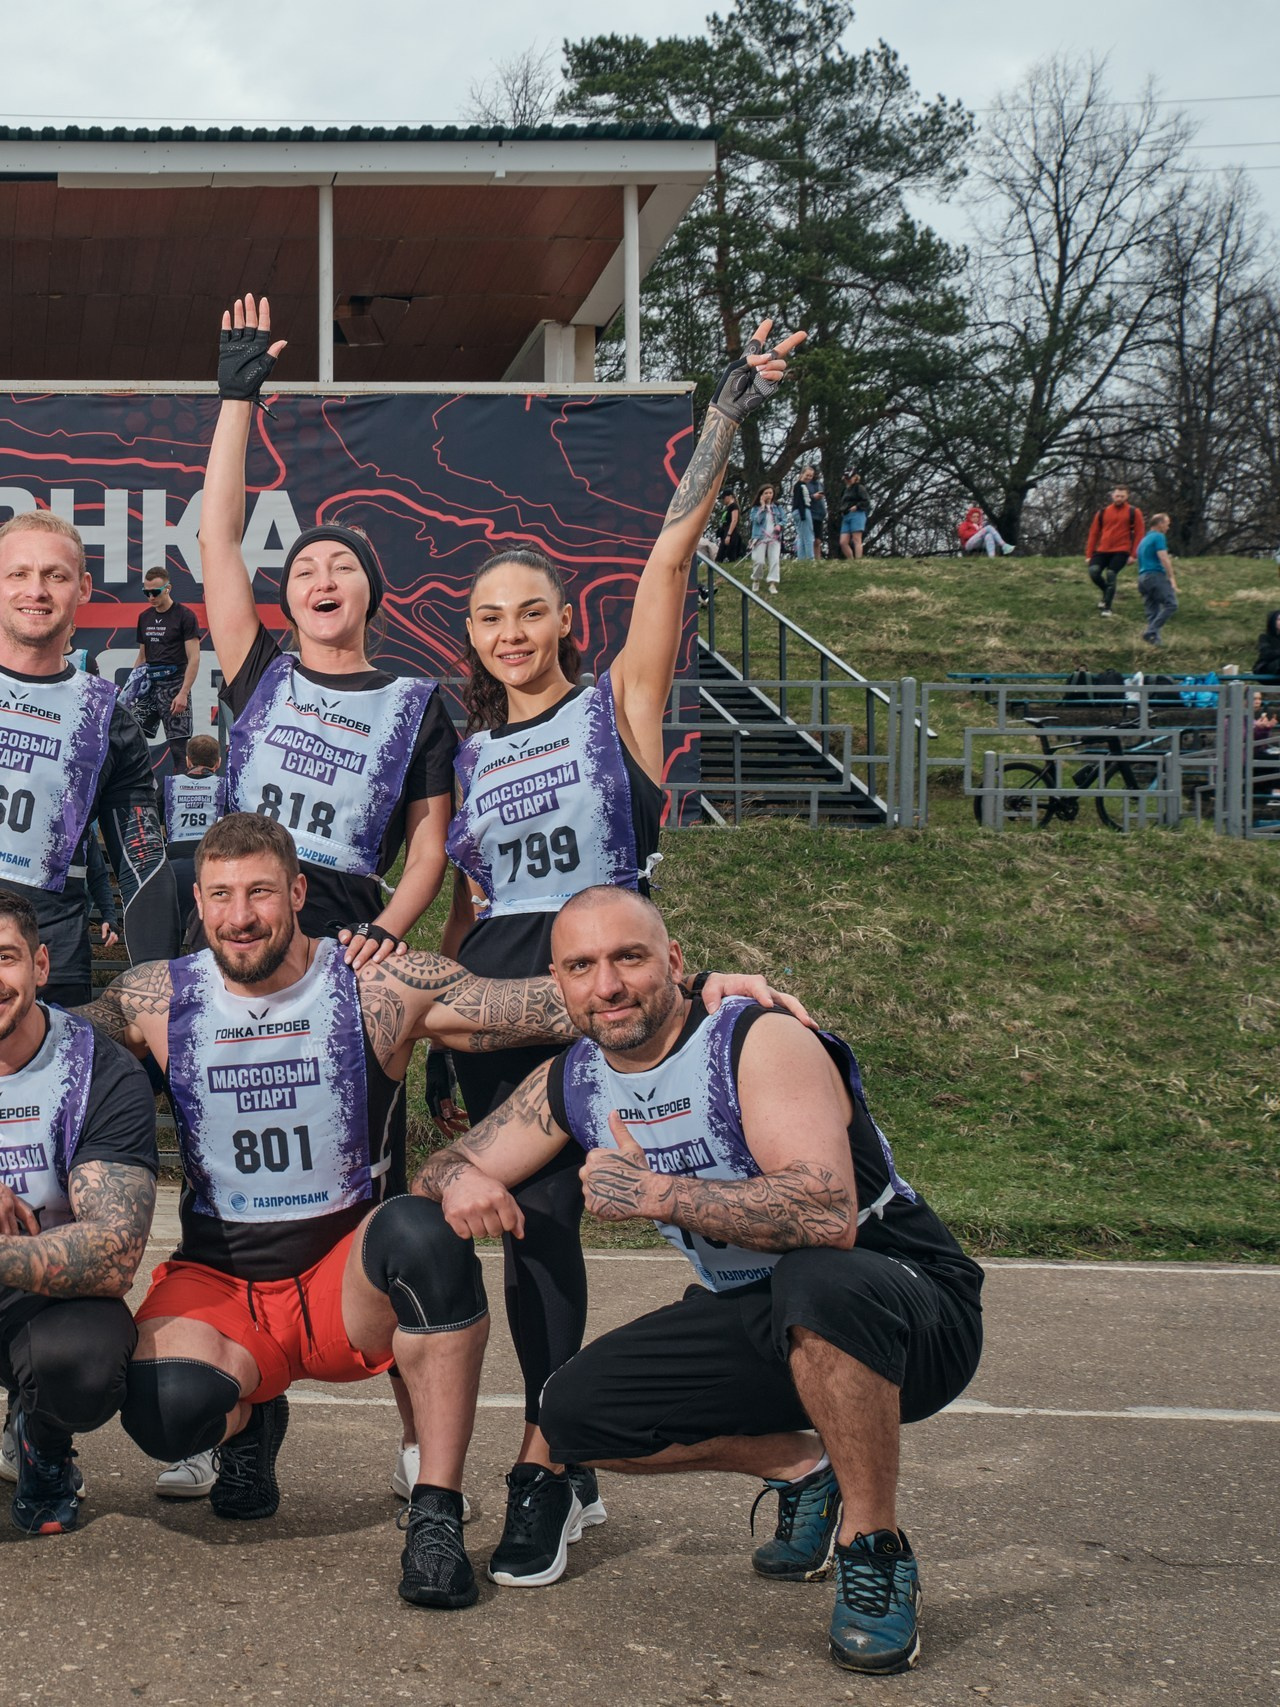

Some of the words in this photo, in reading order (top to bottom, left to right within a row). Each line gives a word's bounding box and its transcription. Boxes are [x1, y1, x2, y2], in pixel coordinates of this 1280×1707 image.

[14, 703, 62, 721] ГЕРОЕВ
[323, 712, 371, 733] ГЕРОЕВ
[271, 728, 363, 772] МАССОВЫЙ
[478, 755, 516, 778] ГОНКА
[519, 737, 570, 759] ГЕРОЕВ
[285, 752, 335, 782] СТАРТ
[479, 762, 576, 813] МАССОВЫЙ
[181, 813, 207, 827] 769
[257, 783, 336, 839] 818
[502, 791, 555, 822] СТАРТ
[498, 825, 581, 883] 799
[215, 1026, 255, 1040] ГОНКА
[258, 1019, 310, 1035] ГЕРОЕВ
[212, 1057, 316, 1089] МАССОВЫЙ
[240, 1087, 292, 1111] СТАРТ
[647, 1097, 691, 1119] ГЕРОЕВ
[232, 1125, 313, 1174] 801
[645, 1139, 710, 1173] ССОВЫЙ
[253, 1190, 330, 1208] ГАЗПРОМБАНК
